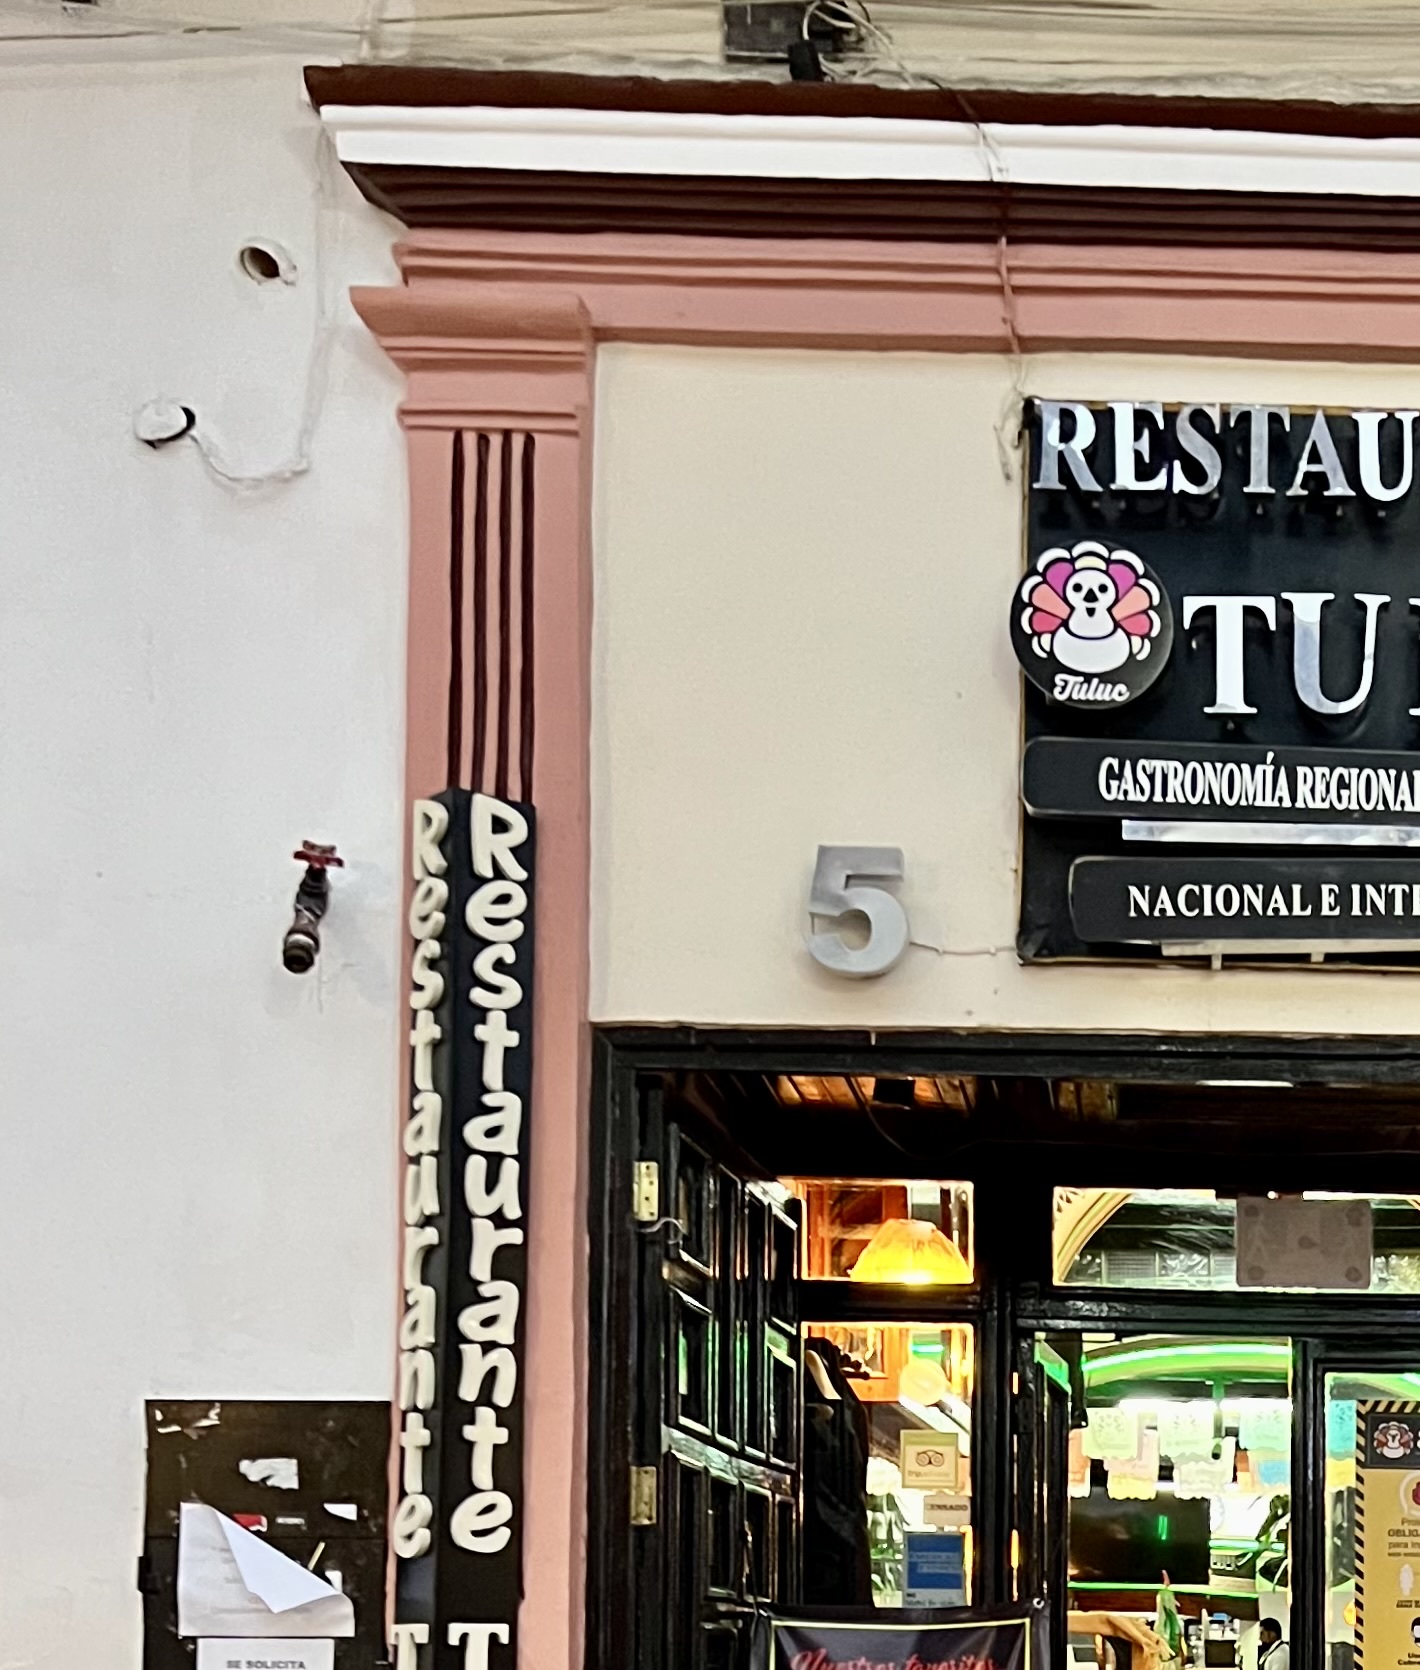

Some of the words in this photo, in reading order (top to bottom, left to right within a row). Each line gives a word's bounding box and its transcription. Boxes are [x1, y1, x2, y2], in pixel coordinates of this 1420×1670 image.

[1053, 673, 1130, 702] Tuluc
[1098, 751, 1293, 808] GASTRONOMÍA
[805, 844, 911, 977] 5
[1127, 883, 1312, 918] NACIONAL
[1320, 884, 1341, 917] E
[393, 799, 449, 1559] Restaurante
[449, 792, 530, 1555] Restaurante
